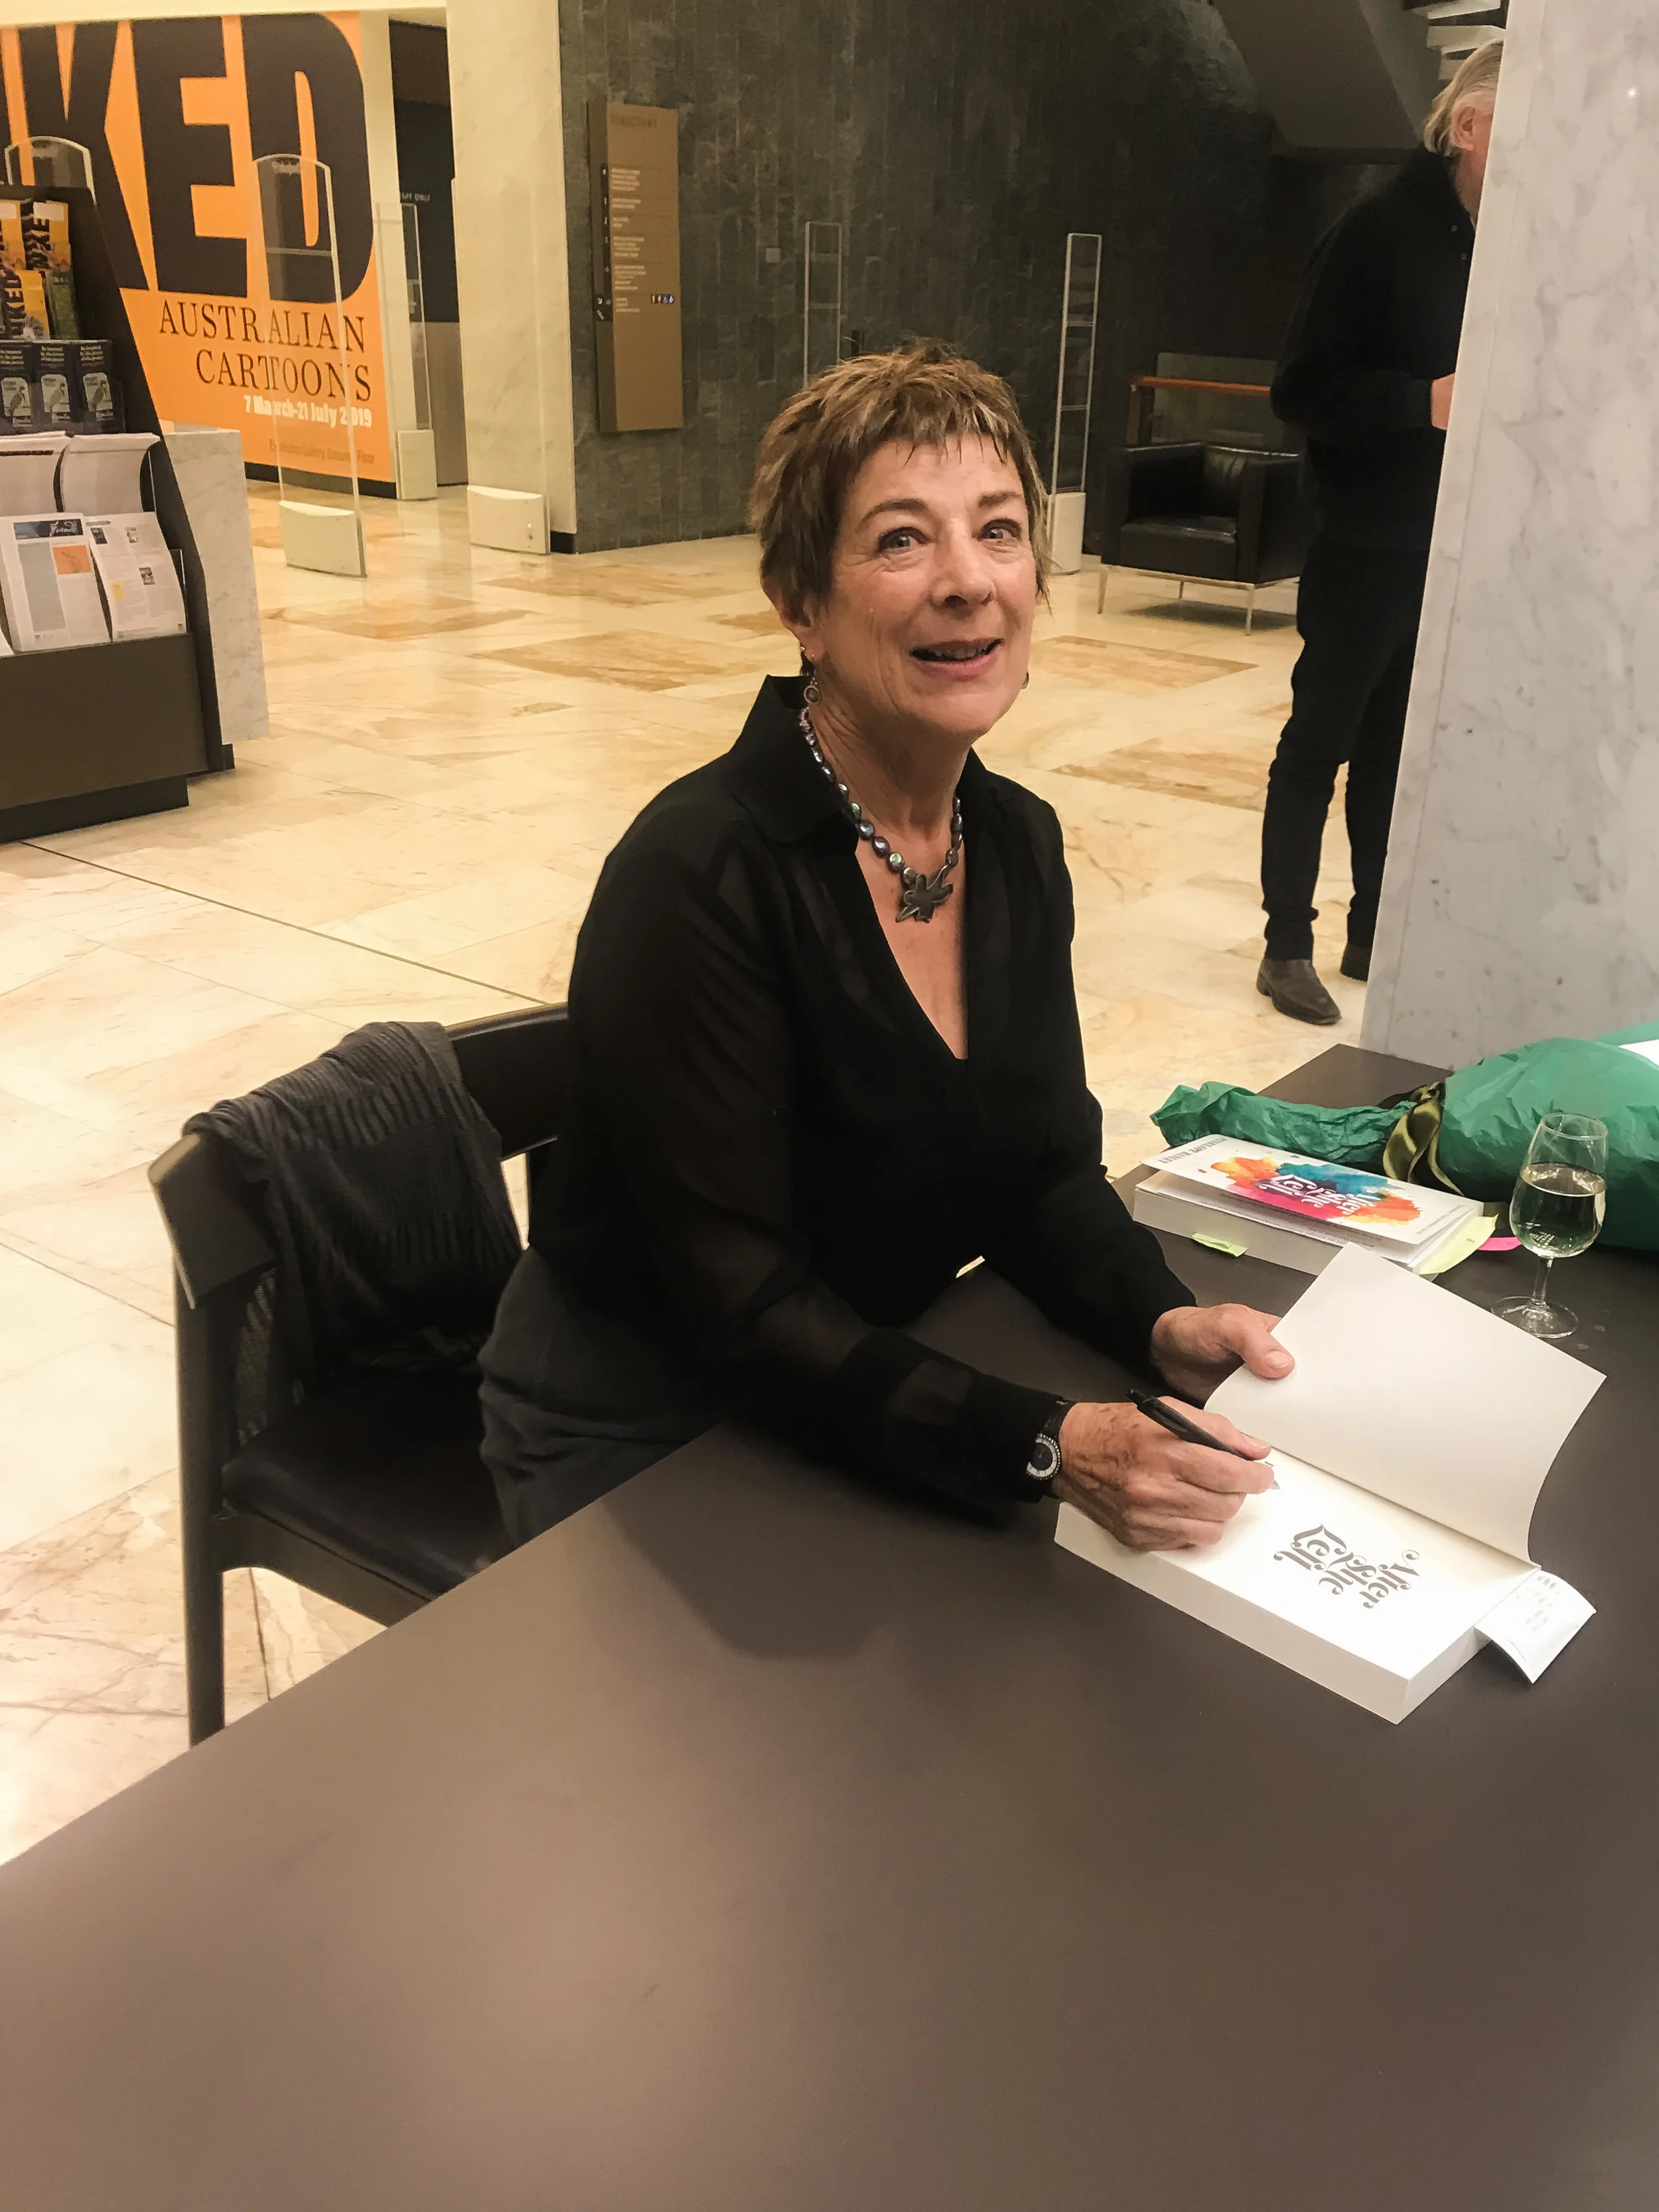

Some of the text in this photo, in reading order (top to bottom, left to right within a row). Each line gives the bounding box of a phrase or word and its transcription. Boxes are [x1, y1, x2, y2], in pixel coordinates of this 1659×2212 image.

[0, 13, 374, 303] KED
[159, 299, 364, 353] AUSTRALIAN
[196, 349, 371, 402] CARTOONS
[244, 394, 252, 413] 7
[311, 403, 338, 429] July
[340, 406, 372, 429] 2019
[1159, 1151, 1191, 1164] HANLEY
[1259, 1174, 1317, 1195] Left
[1273, 1523, 1347, 1571] Left
[1359, 1550, 1420, 1609] After
